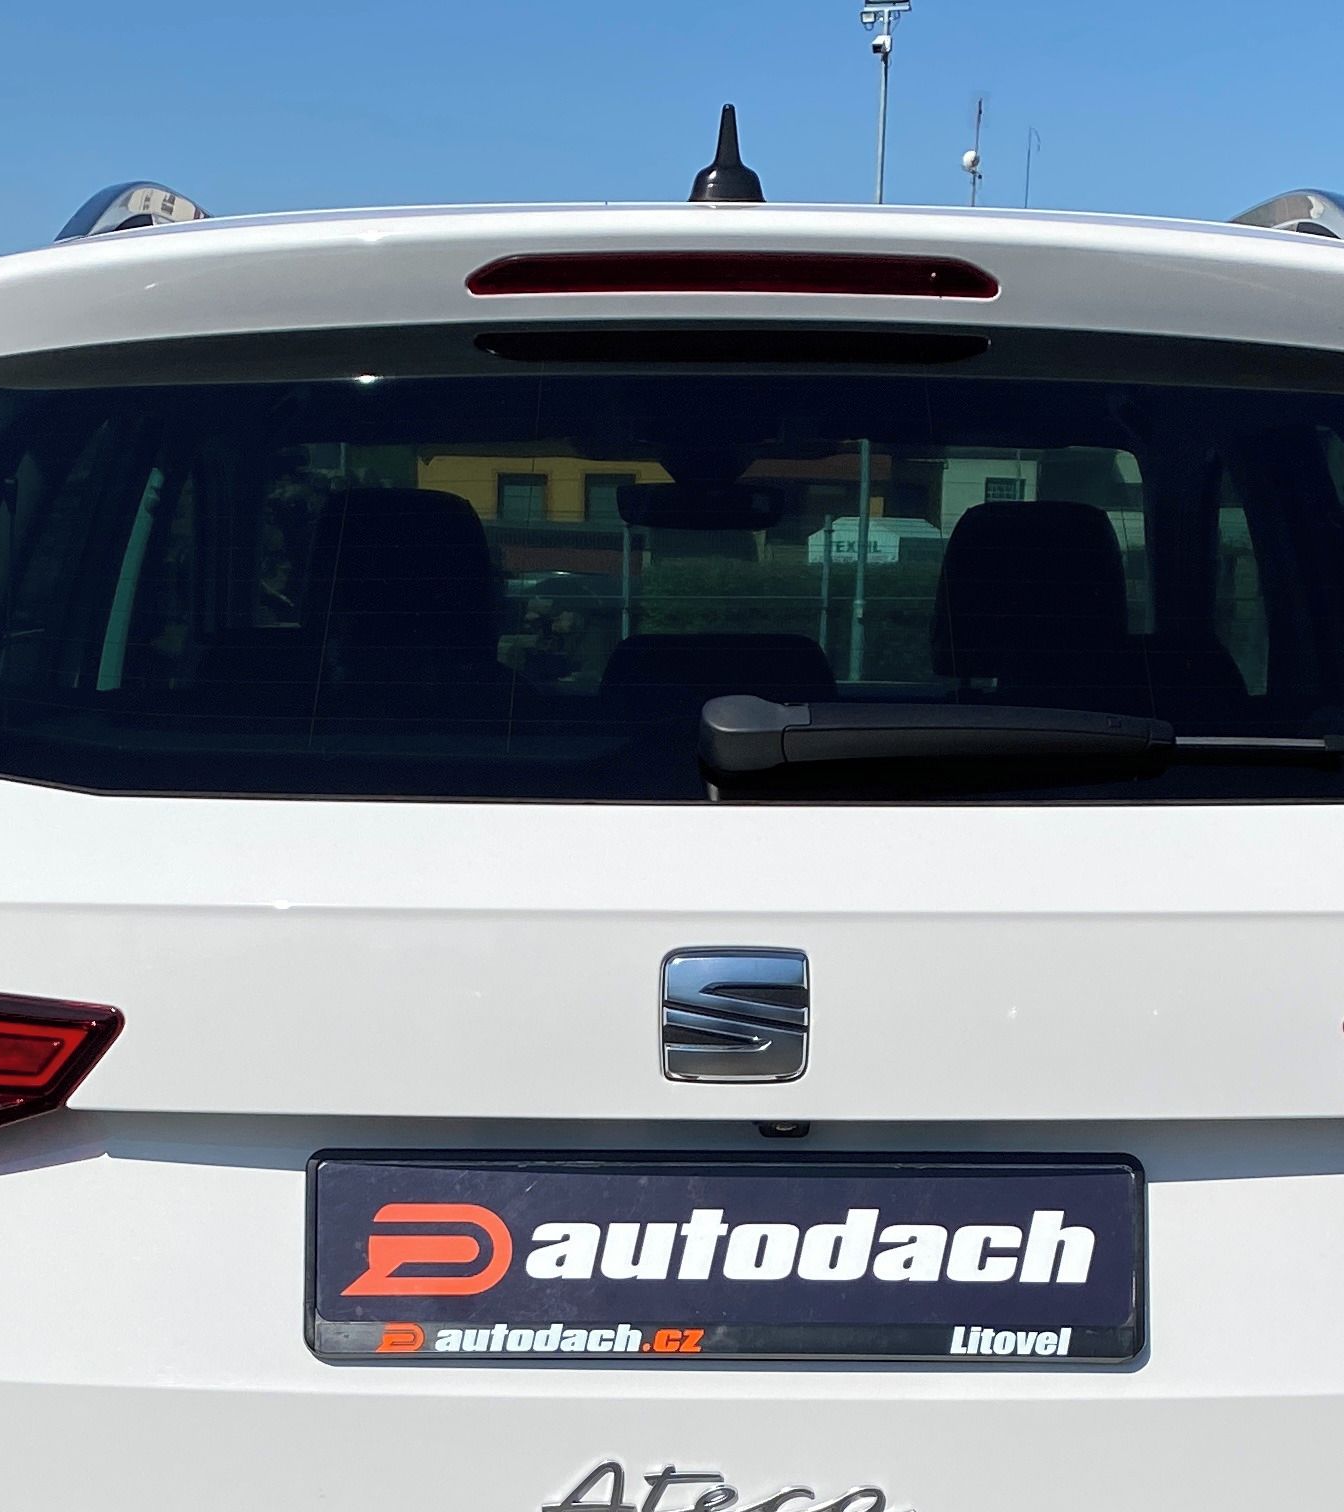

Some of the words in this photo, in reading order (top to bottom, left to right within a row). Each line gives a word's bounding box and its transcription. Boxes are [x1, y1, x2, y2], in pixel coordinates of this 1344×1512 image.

[827, 541, 882, 553] EXIL
[525, 1208, 1096, 1284] autodach
[434, 1323, 705, 1353] autodach.cz
[950, 1326, 1072, 1356] Litovel
